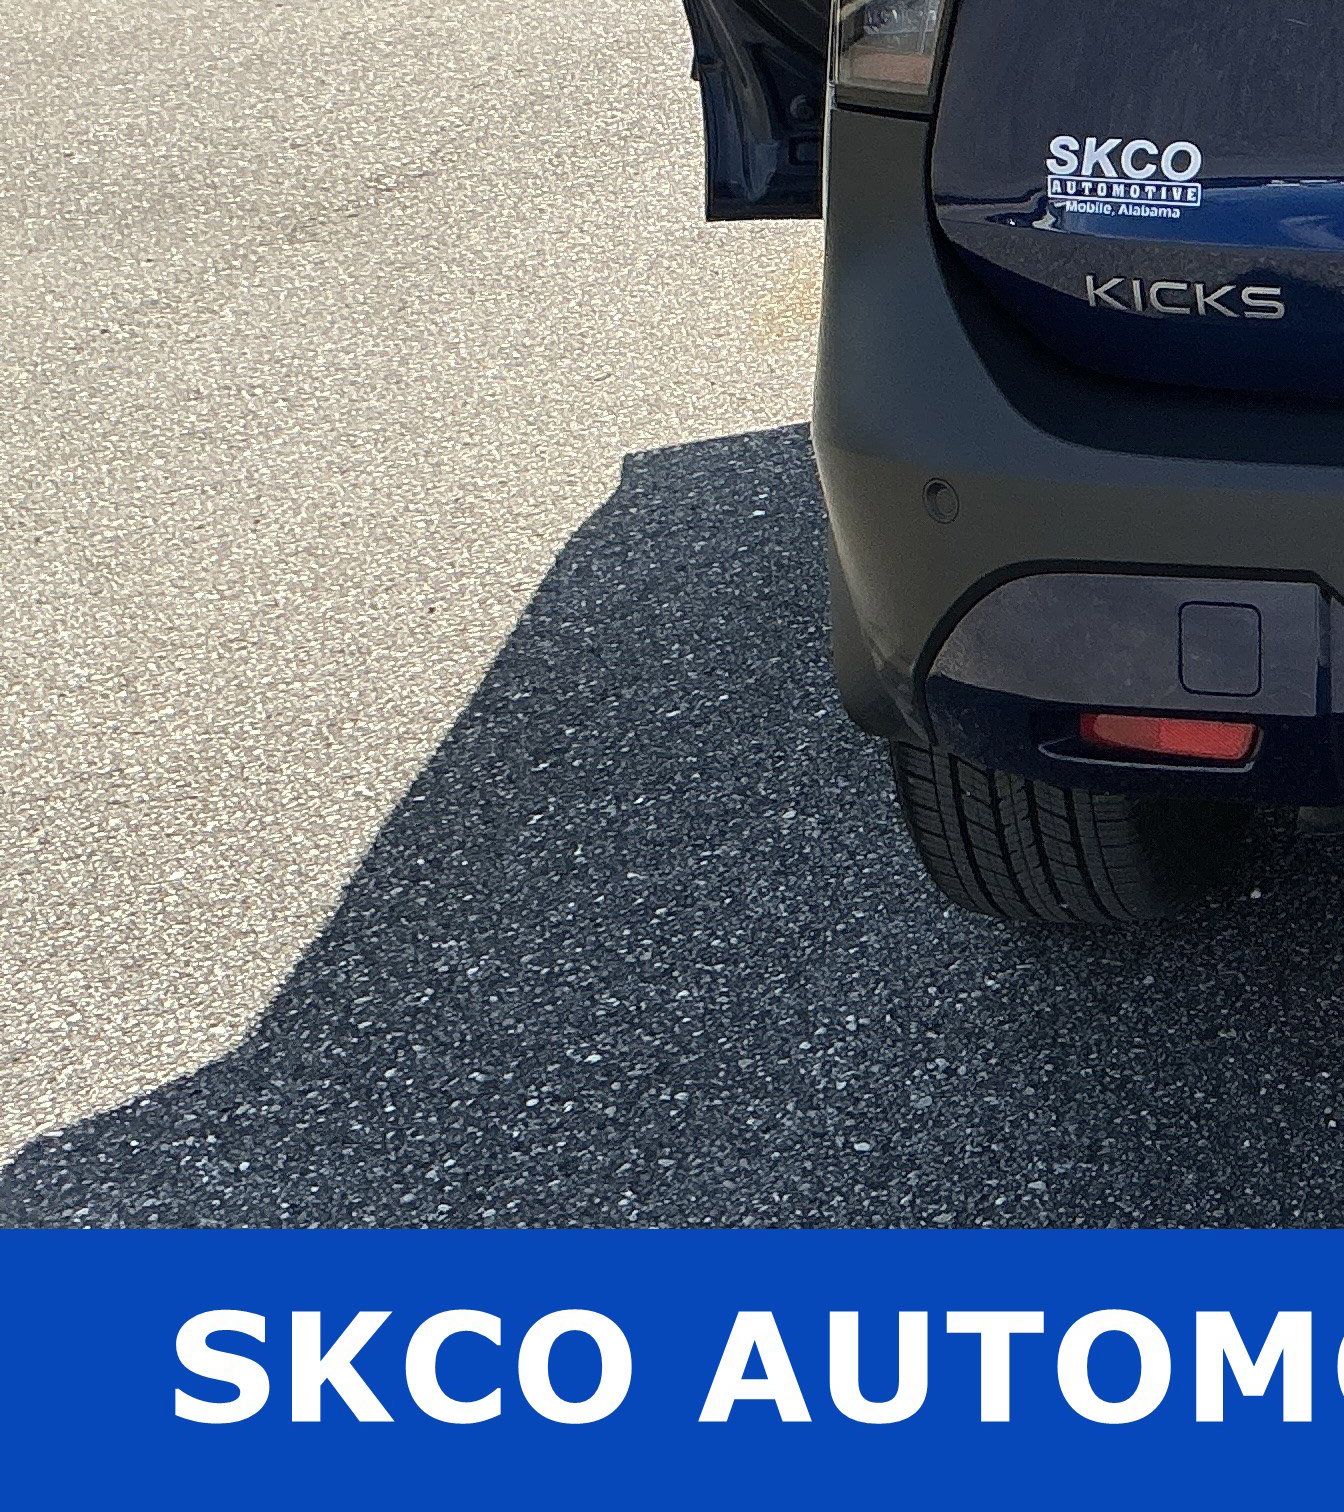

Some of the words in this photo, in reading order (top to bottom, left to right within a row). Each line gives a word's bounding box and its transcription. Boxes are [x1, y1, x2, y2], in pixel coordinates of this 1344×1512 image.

[1046, 135, 1202, 181] SKCO
[1051, 180, 1197, 202] AUTOMOTIVE
[1065, 200, 1116, 217] Mobile,
[1119, 203, 1181, 219] Alabama
[1086, 274, 1285, 319] KICKS
